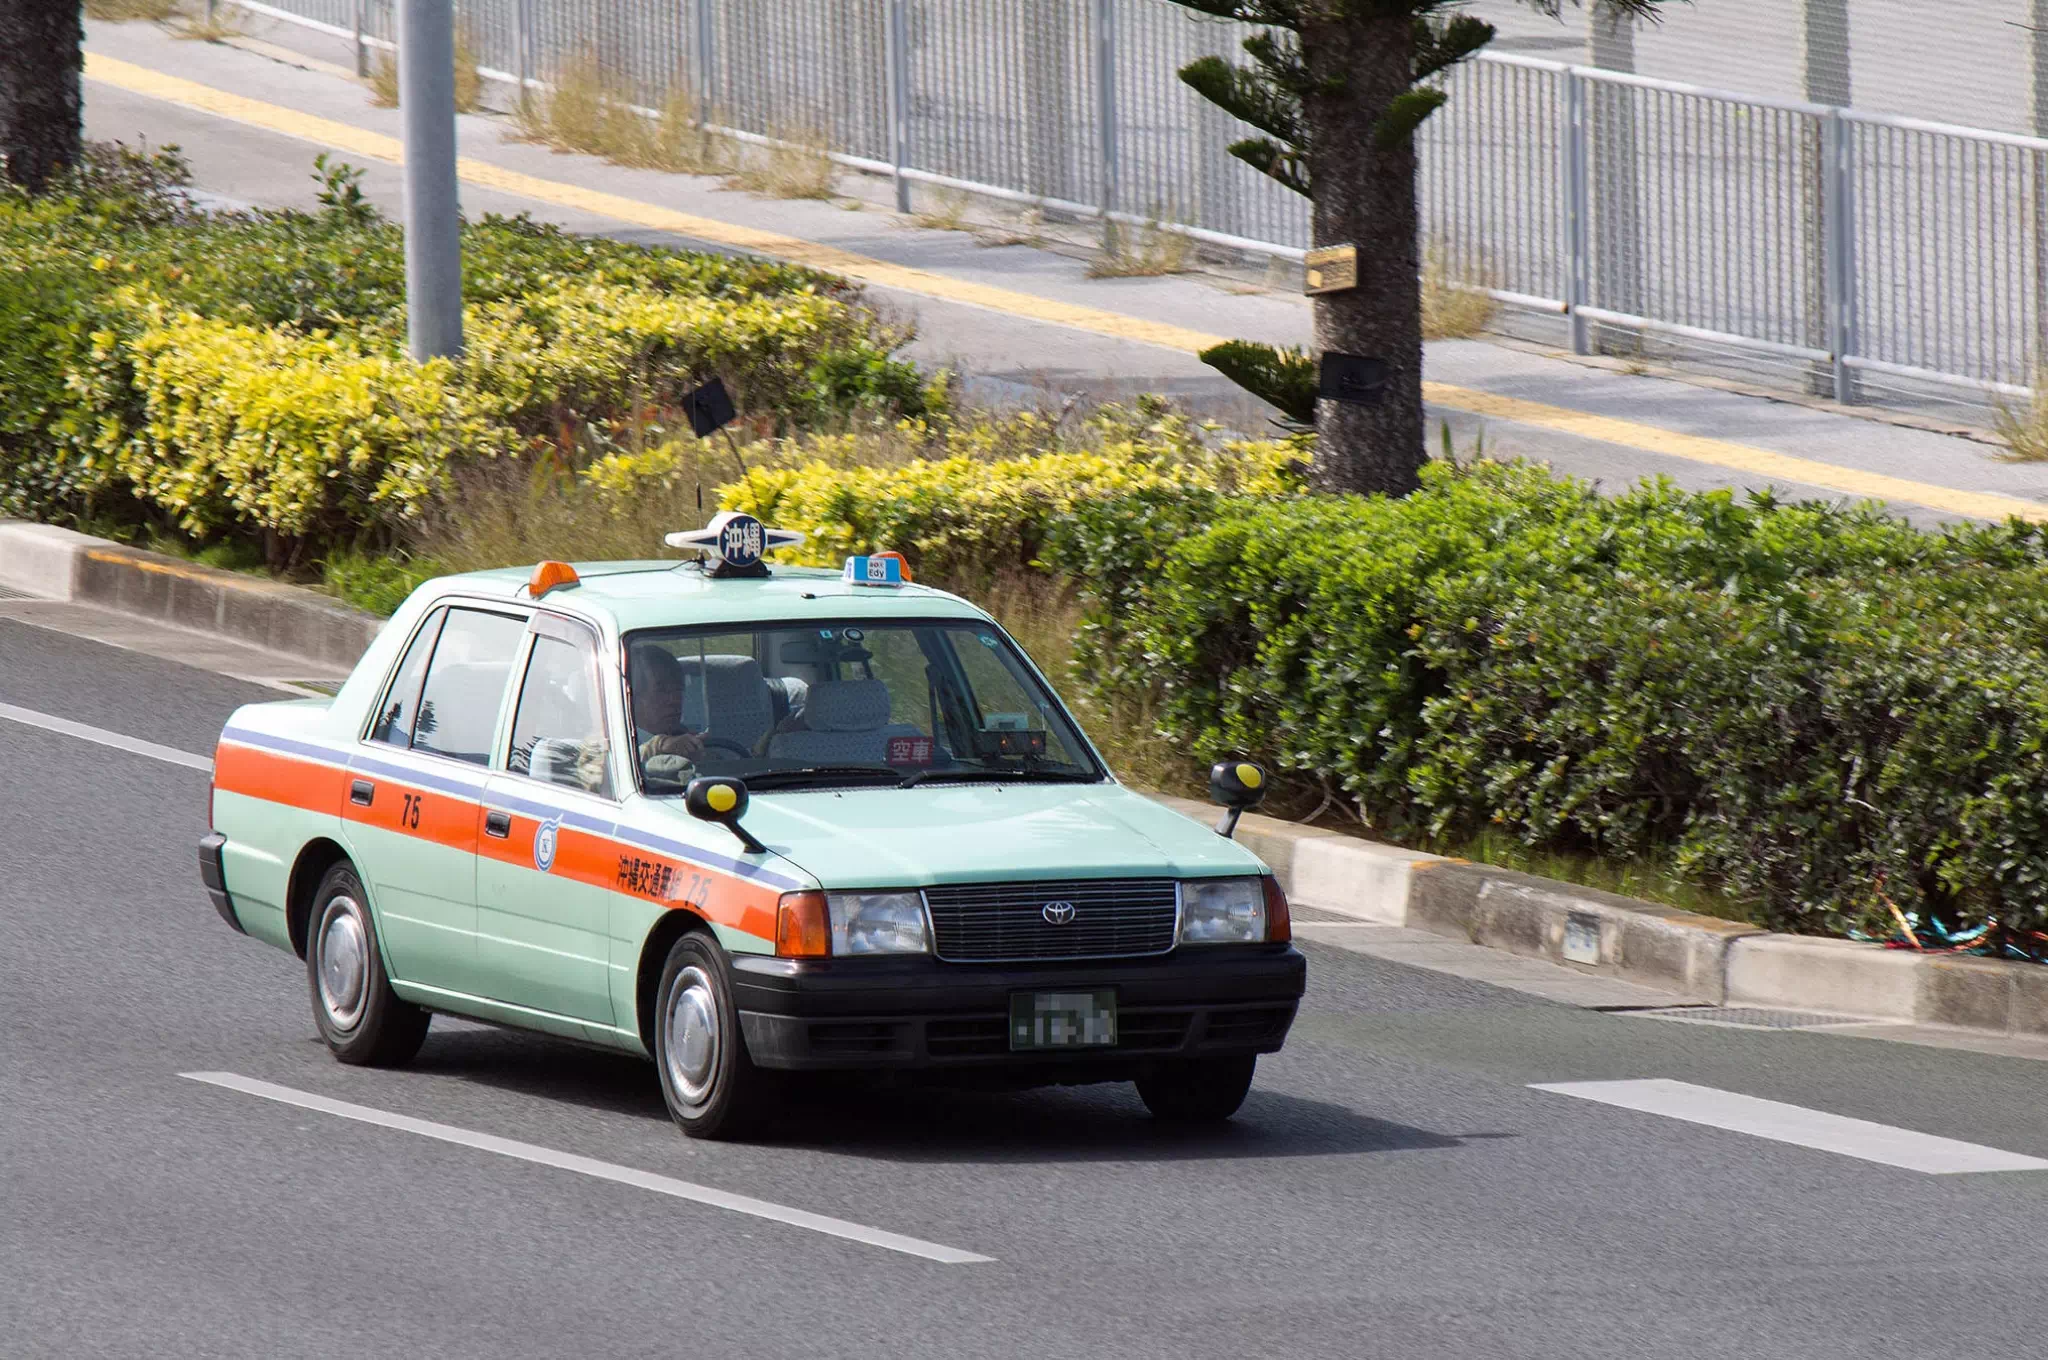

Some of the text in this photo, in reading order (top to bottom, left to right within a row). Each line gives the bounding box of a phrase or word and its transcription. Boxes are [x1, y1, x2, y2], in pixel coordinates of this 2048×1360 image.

[724, 522, 760, 558] 沖縄
[869, 569, 884, 578] Edy
[892, 739, 929, 763] 空車
[402, 793, 422, 830] 75
[684, 873, 713, 910] 75
